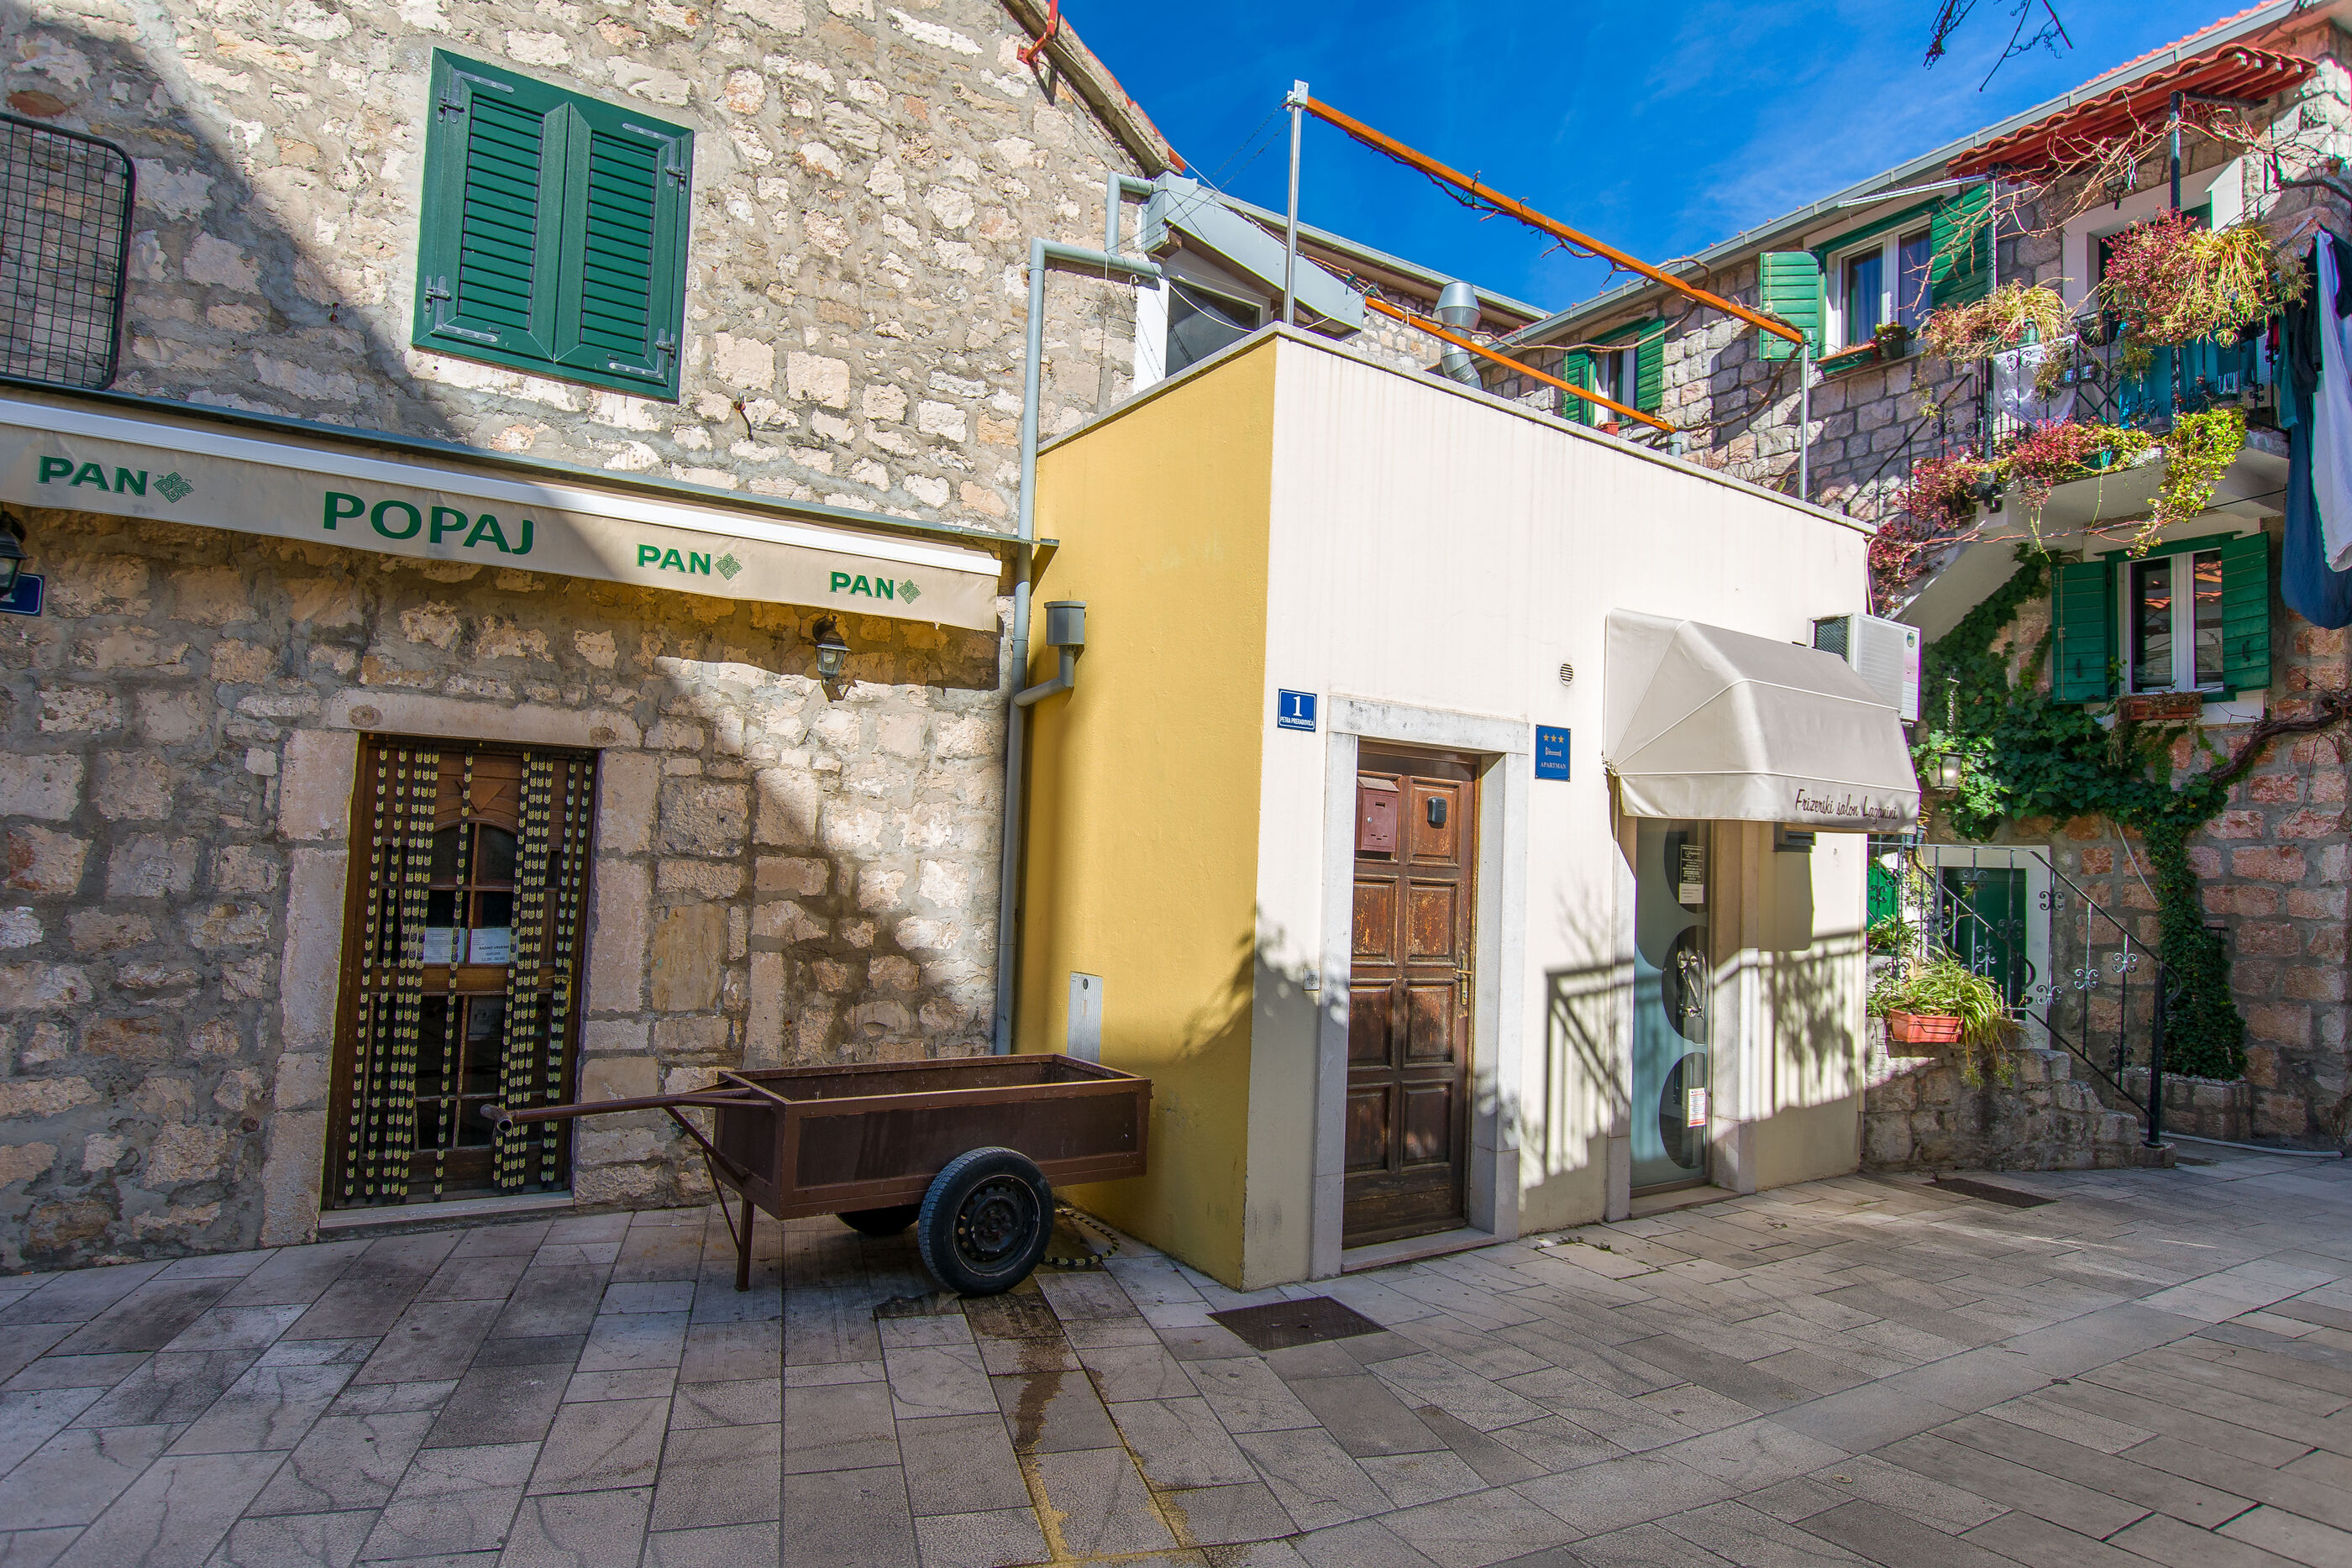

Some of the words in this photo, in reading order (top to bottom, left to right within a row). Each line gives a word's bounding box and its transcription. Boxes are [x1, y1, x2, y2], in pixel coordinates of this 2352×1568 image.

[37, 455, 149, 497] PAN
[323, 490, 535, 556] POPAJ
[636, 543, 711, 576] PAN
[829, 571, 895, 600] PAN
[1293, 695, 1302, 716] 1
[1795, 789, 1834, 815] Frizerski
[1835, 794, 1860, 817] salon
[1862, 795, 1898, 825] Laganini
